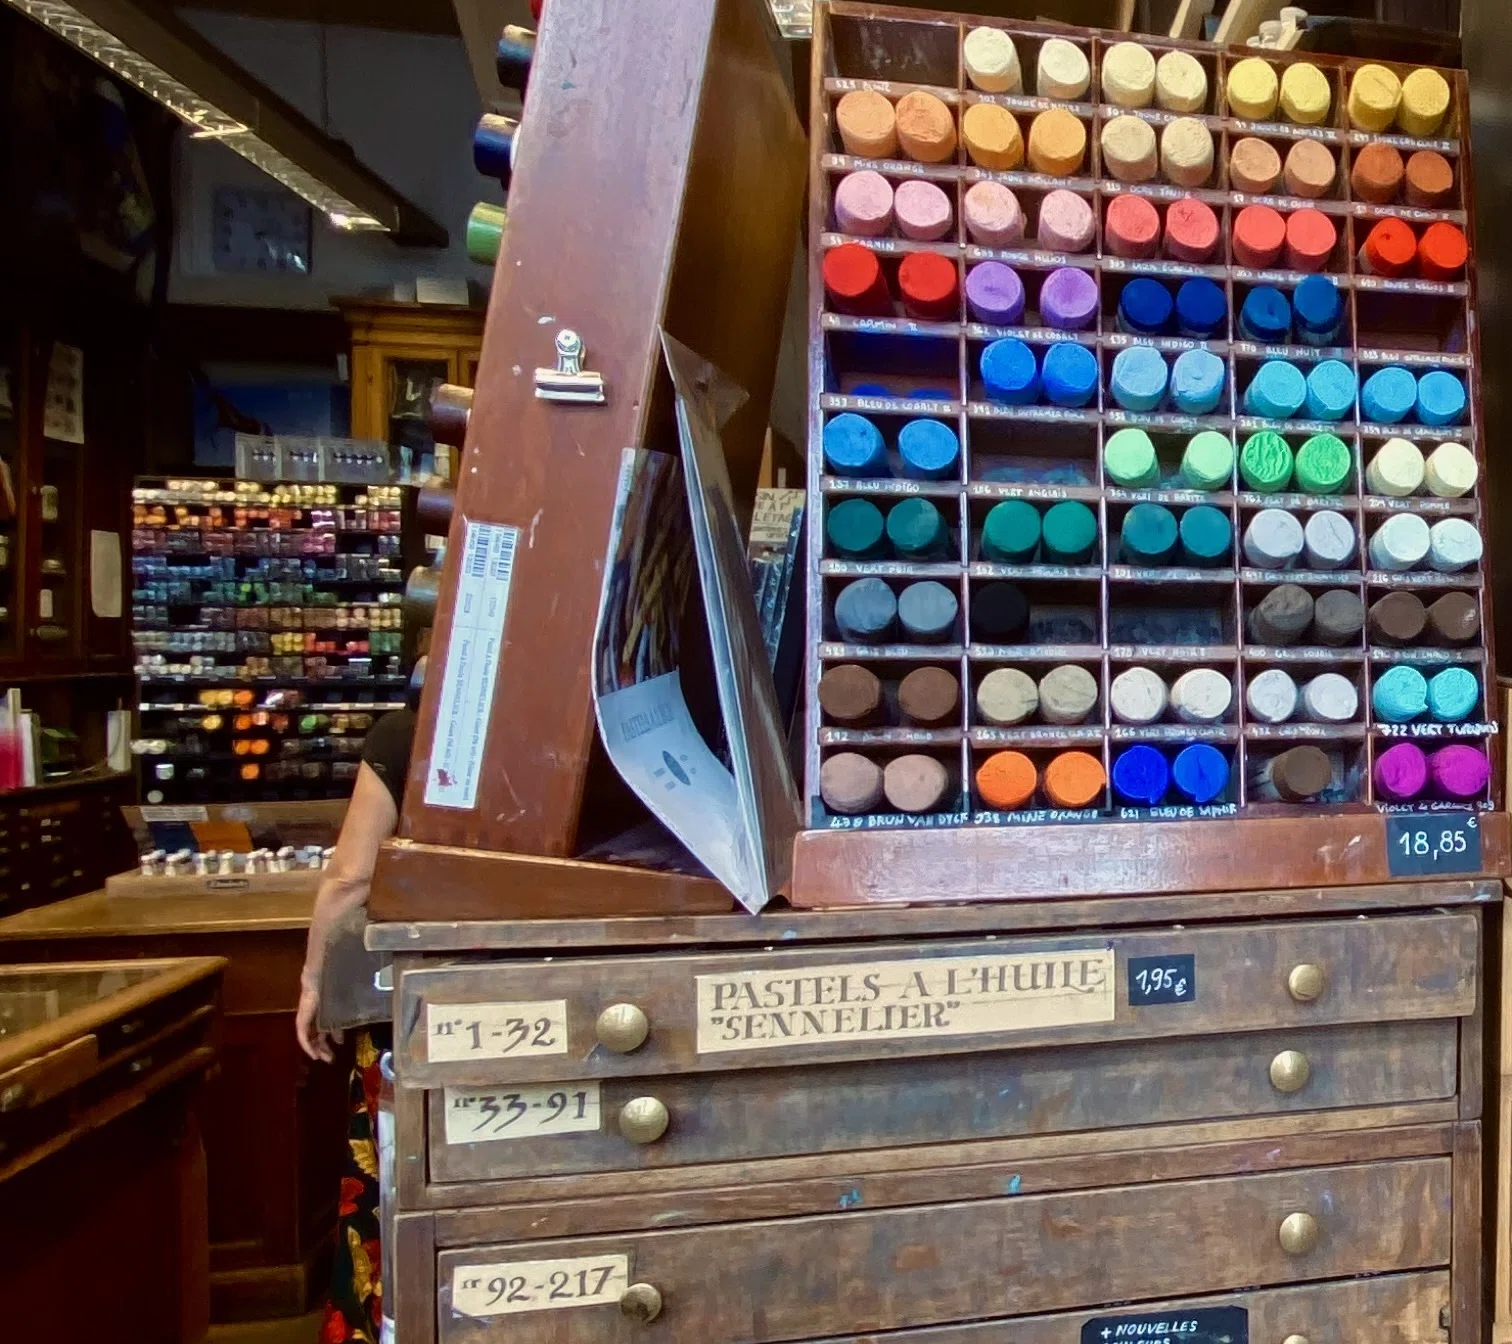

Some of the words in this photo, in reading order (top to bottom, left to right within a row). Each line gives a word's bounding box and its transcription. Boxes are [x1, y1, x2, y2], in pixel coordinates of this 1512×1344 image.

[852, 317, 897, 331] CARMIN
[1160, 339, 1195, 350] INDIGO
[857, 398, 883, 409] BLEU
[856, 481, 880, 492] BLEU
[884, 483, 919, 494] INDIGO
[998, 487, 1023, 498] VERT
[1027, 487, 1067, 498] ANGLAIS
[1388, 498, 1411, 508] VERT
[856, 563, 883, 574] VERT
[1411, 722, 1444, 736] VERT
[867, 814, 904, 828] BRUN
[1399, 830, 1467, 860] 18,85
[1467, 817, 1478, 828] €
[713, 972, 882, 1011] PASTELS
[901, 969, 932, 999] A
[946, 957, 1105, 997] L'HUILE
[1135, 968, 1175, 997] 1,95
[1115, 1320, 1198, 1337] NOUVELLES
